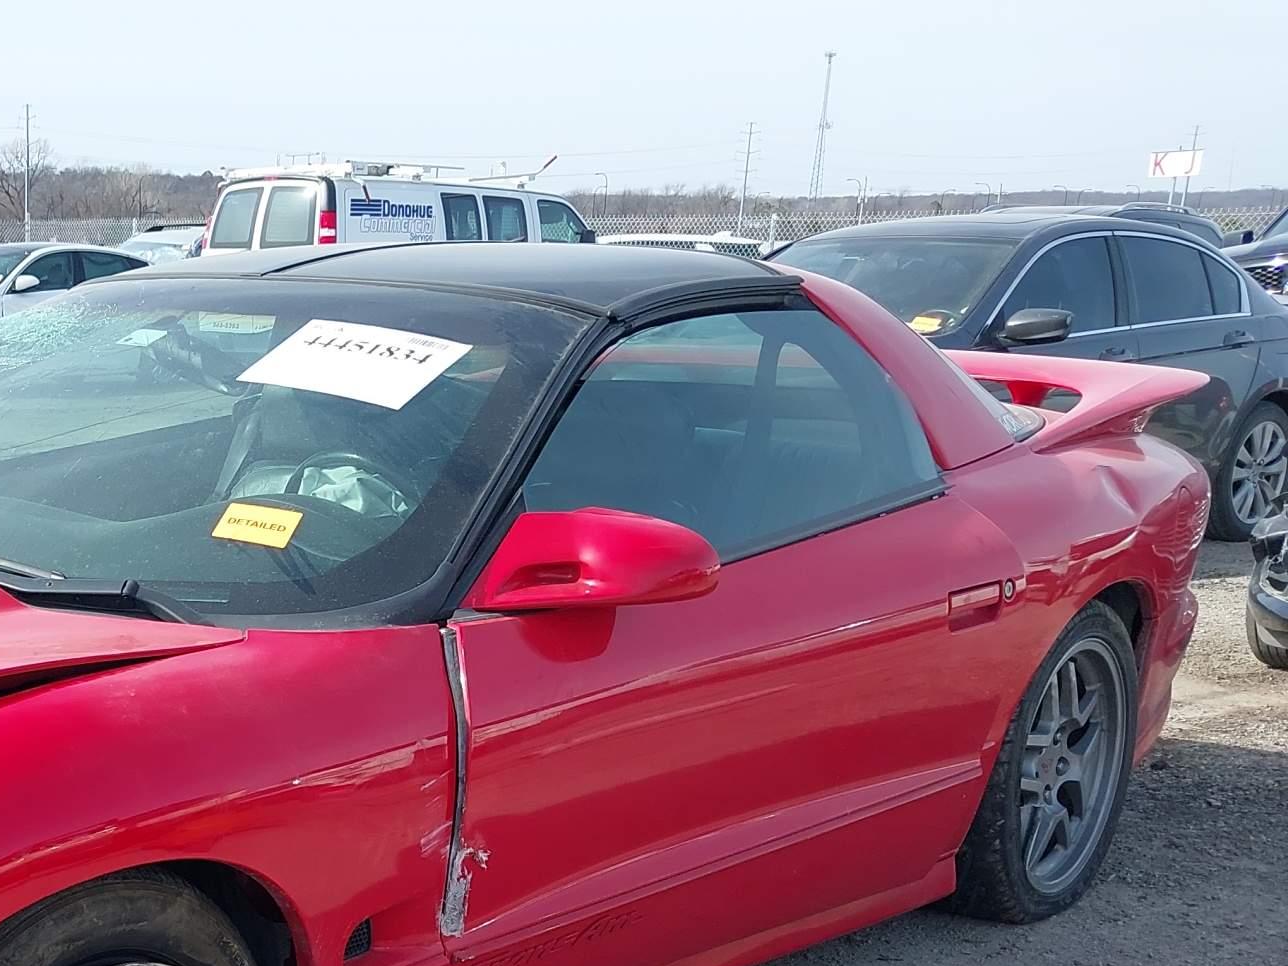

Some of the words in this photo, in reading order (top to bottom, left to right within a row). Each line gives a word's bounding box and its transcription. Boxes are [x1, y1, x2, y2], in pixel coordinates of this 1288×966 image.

[1153, 152, 1168, 176] K
[1184, 152, 1196, 174] J
[360, 215, 437, 233] Commercial
[304, 335, 432, 364] 44451834
[227, 517, 287, 532] DETAILED
